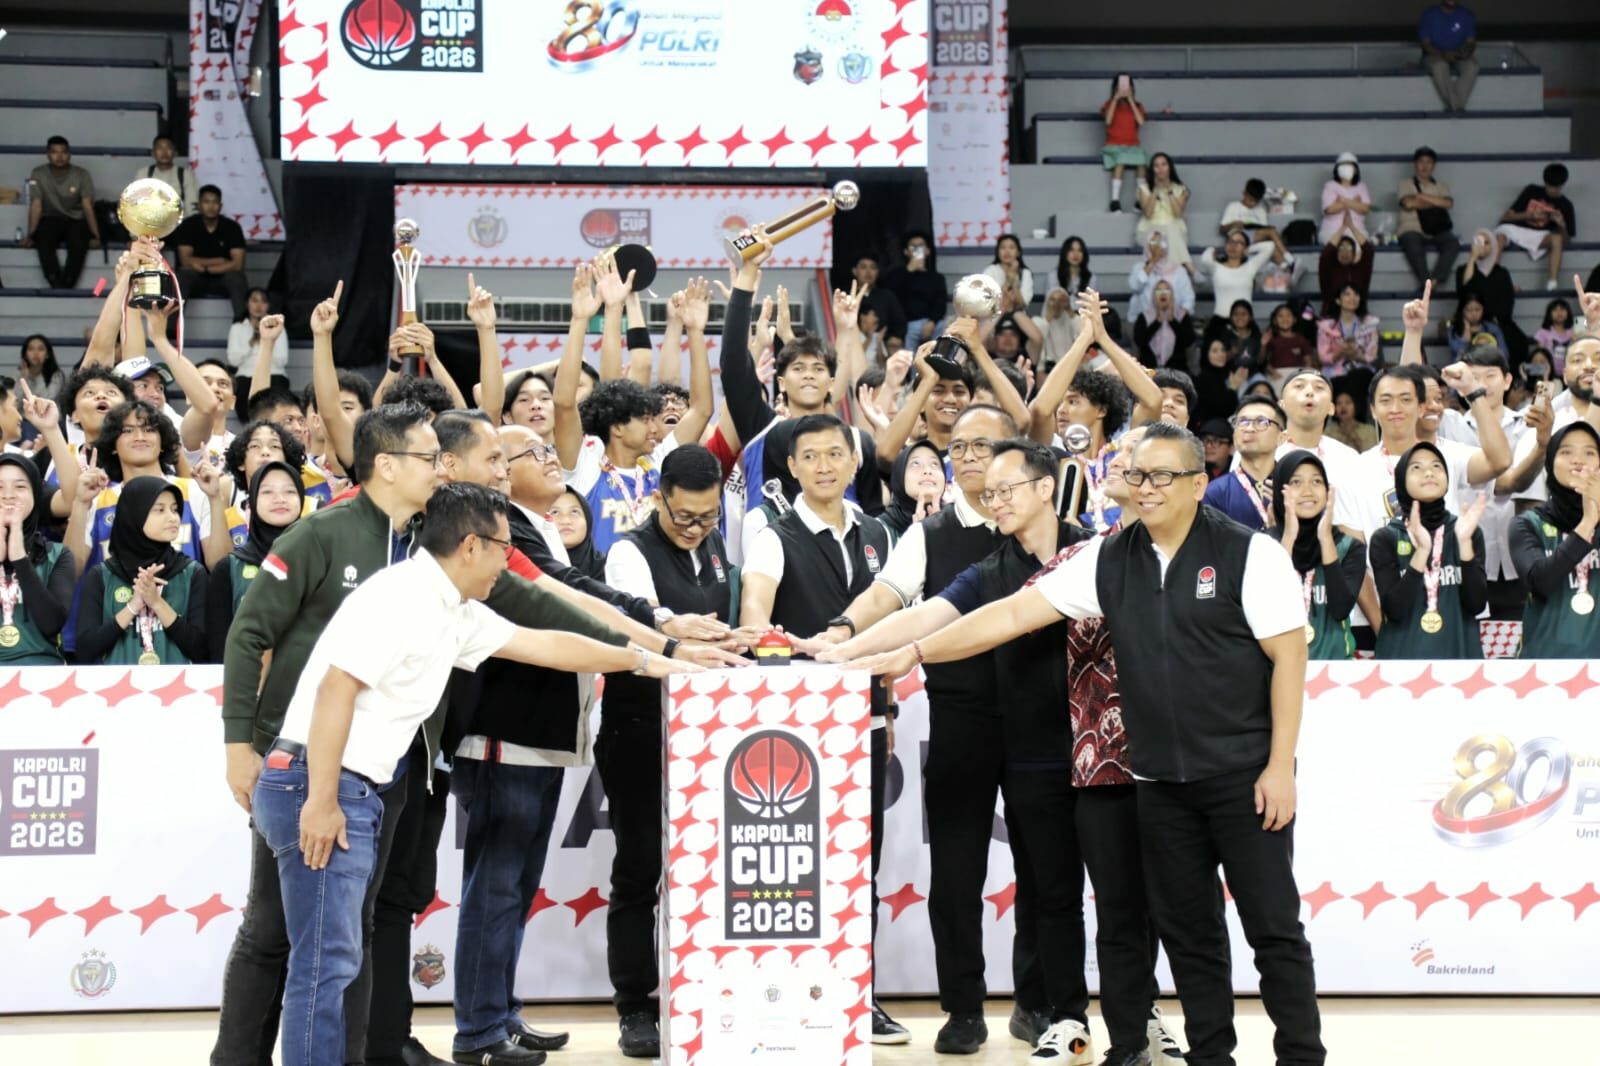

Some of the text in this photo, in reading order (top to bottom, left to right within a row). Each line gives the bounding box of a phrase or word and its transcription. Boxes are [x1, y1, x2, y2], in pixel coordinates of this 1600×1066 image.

[421, 10, 475, 37] CUP
[935, 5, 989, 32] CUP
[421, 46, 476, 68] 2026
[936, 41, 990, 63] 2026
[620, 218, 648, 232] CUP
[13, 757, 87, 773] KAPOLRI
[12, 775, 86, 808] CUP
[10, 821, 84, 848] 2026
[731, 824, 813, 843] KAPOLRI
[731, 845, 813, 885] CUP
[733, 901, 813, 932] 2026
[1426, 964, 1495, 975] Bakrieland
